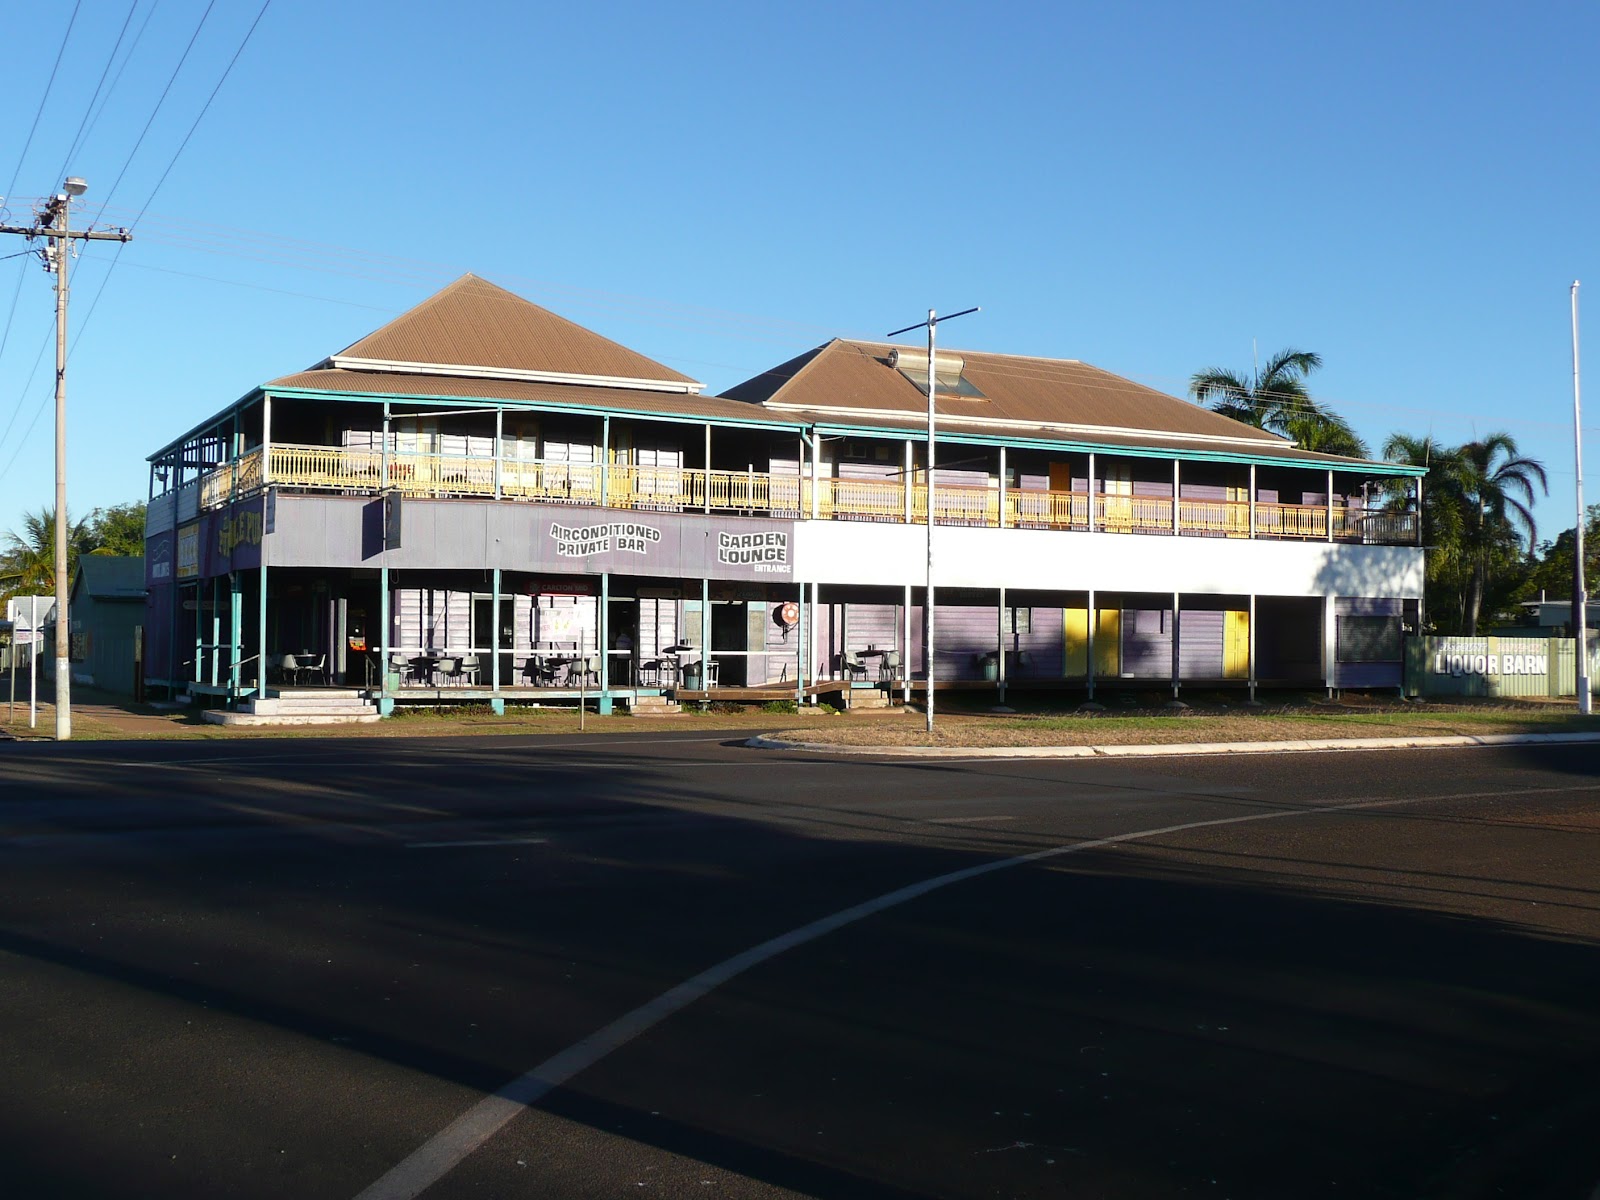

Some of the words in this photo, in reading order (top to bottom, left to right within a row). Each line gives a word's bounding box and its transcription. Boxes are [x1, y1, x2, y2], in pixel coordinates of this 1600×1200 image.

[550, 523, 661, 543] AIRCONDITIONED
[719, 531, 787, 549] GARDEN
[557, 539, 609, 557] PRIVATE
[617, 538, 647, 553] BAR
[718, 547, 787, 564] LOUNGE
[754, 564, 791, 574] ENTRANCE
[1435, 654, 1499, 677] LIQUOR
[1502, 654, 1547, 675] BARN
